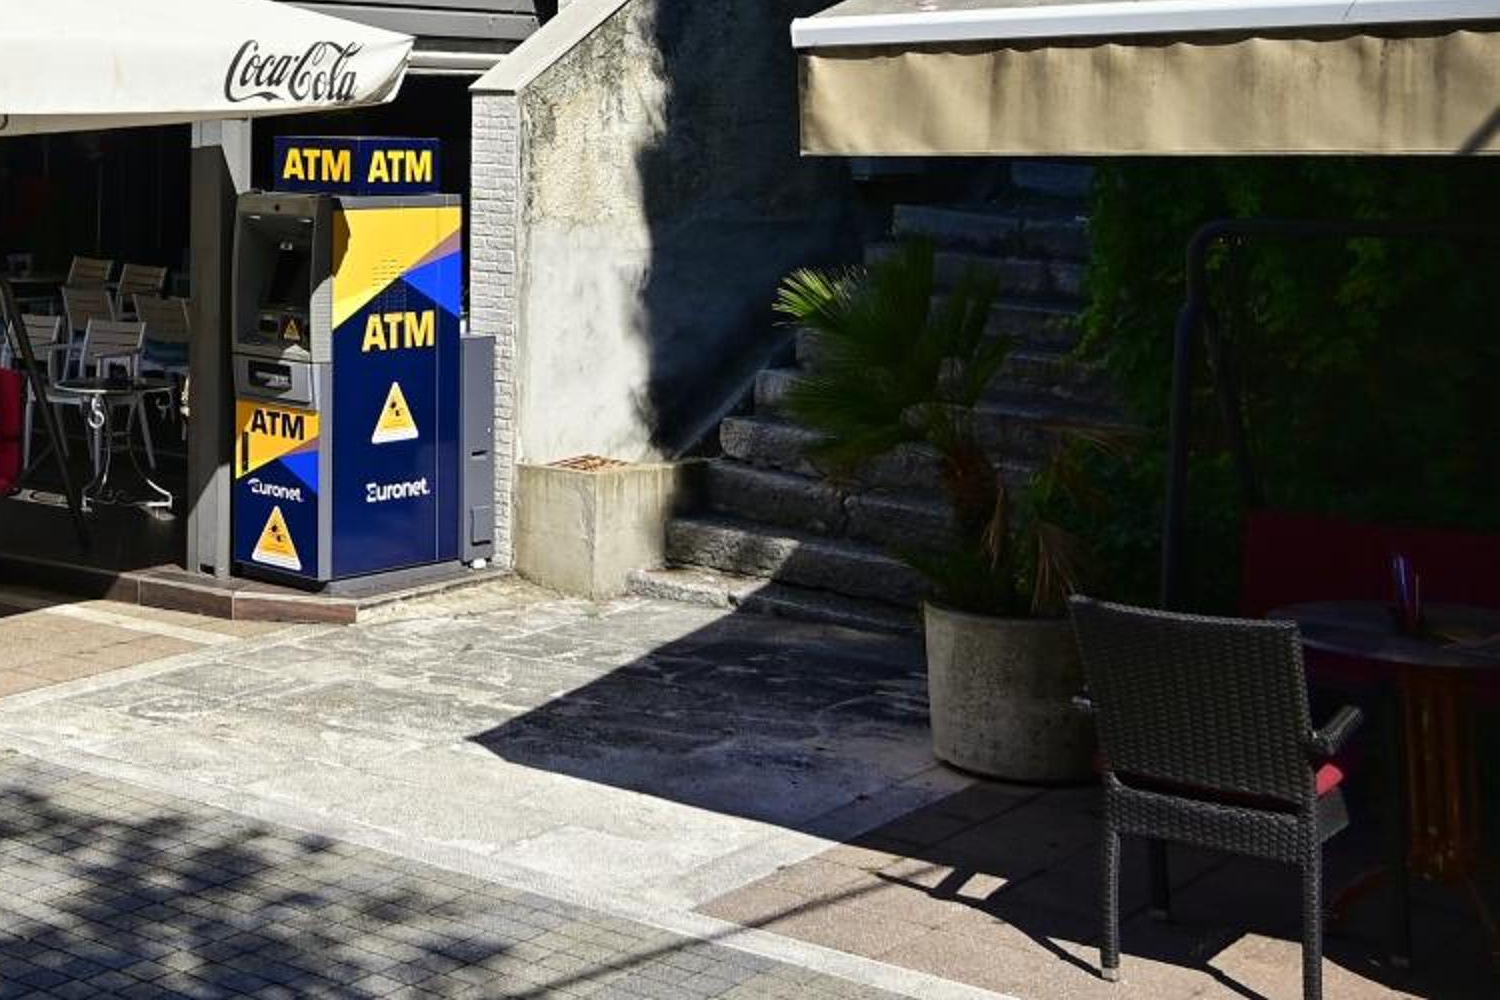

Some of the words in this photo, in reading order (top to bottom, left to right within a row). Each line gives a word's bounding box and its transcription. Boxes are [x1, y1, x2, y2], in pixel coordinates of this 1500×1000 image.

[283, 148, 351, 182] ATM
[367, 150, 432, 183] ATM
[361, 310, 435, 353] ATM
[251, 408, 305, 441] ATM
[247, 478, 304, 503] Euronet
[365, 477, 431, 503] Euronet
